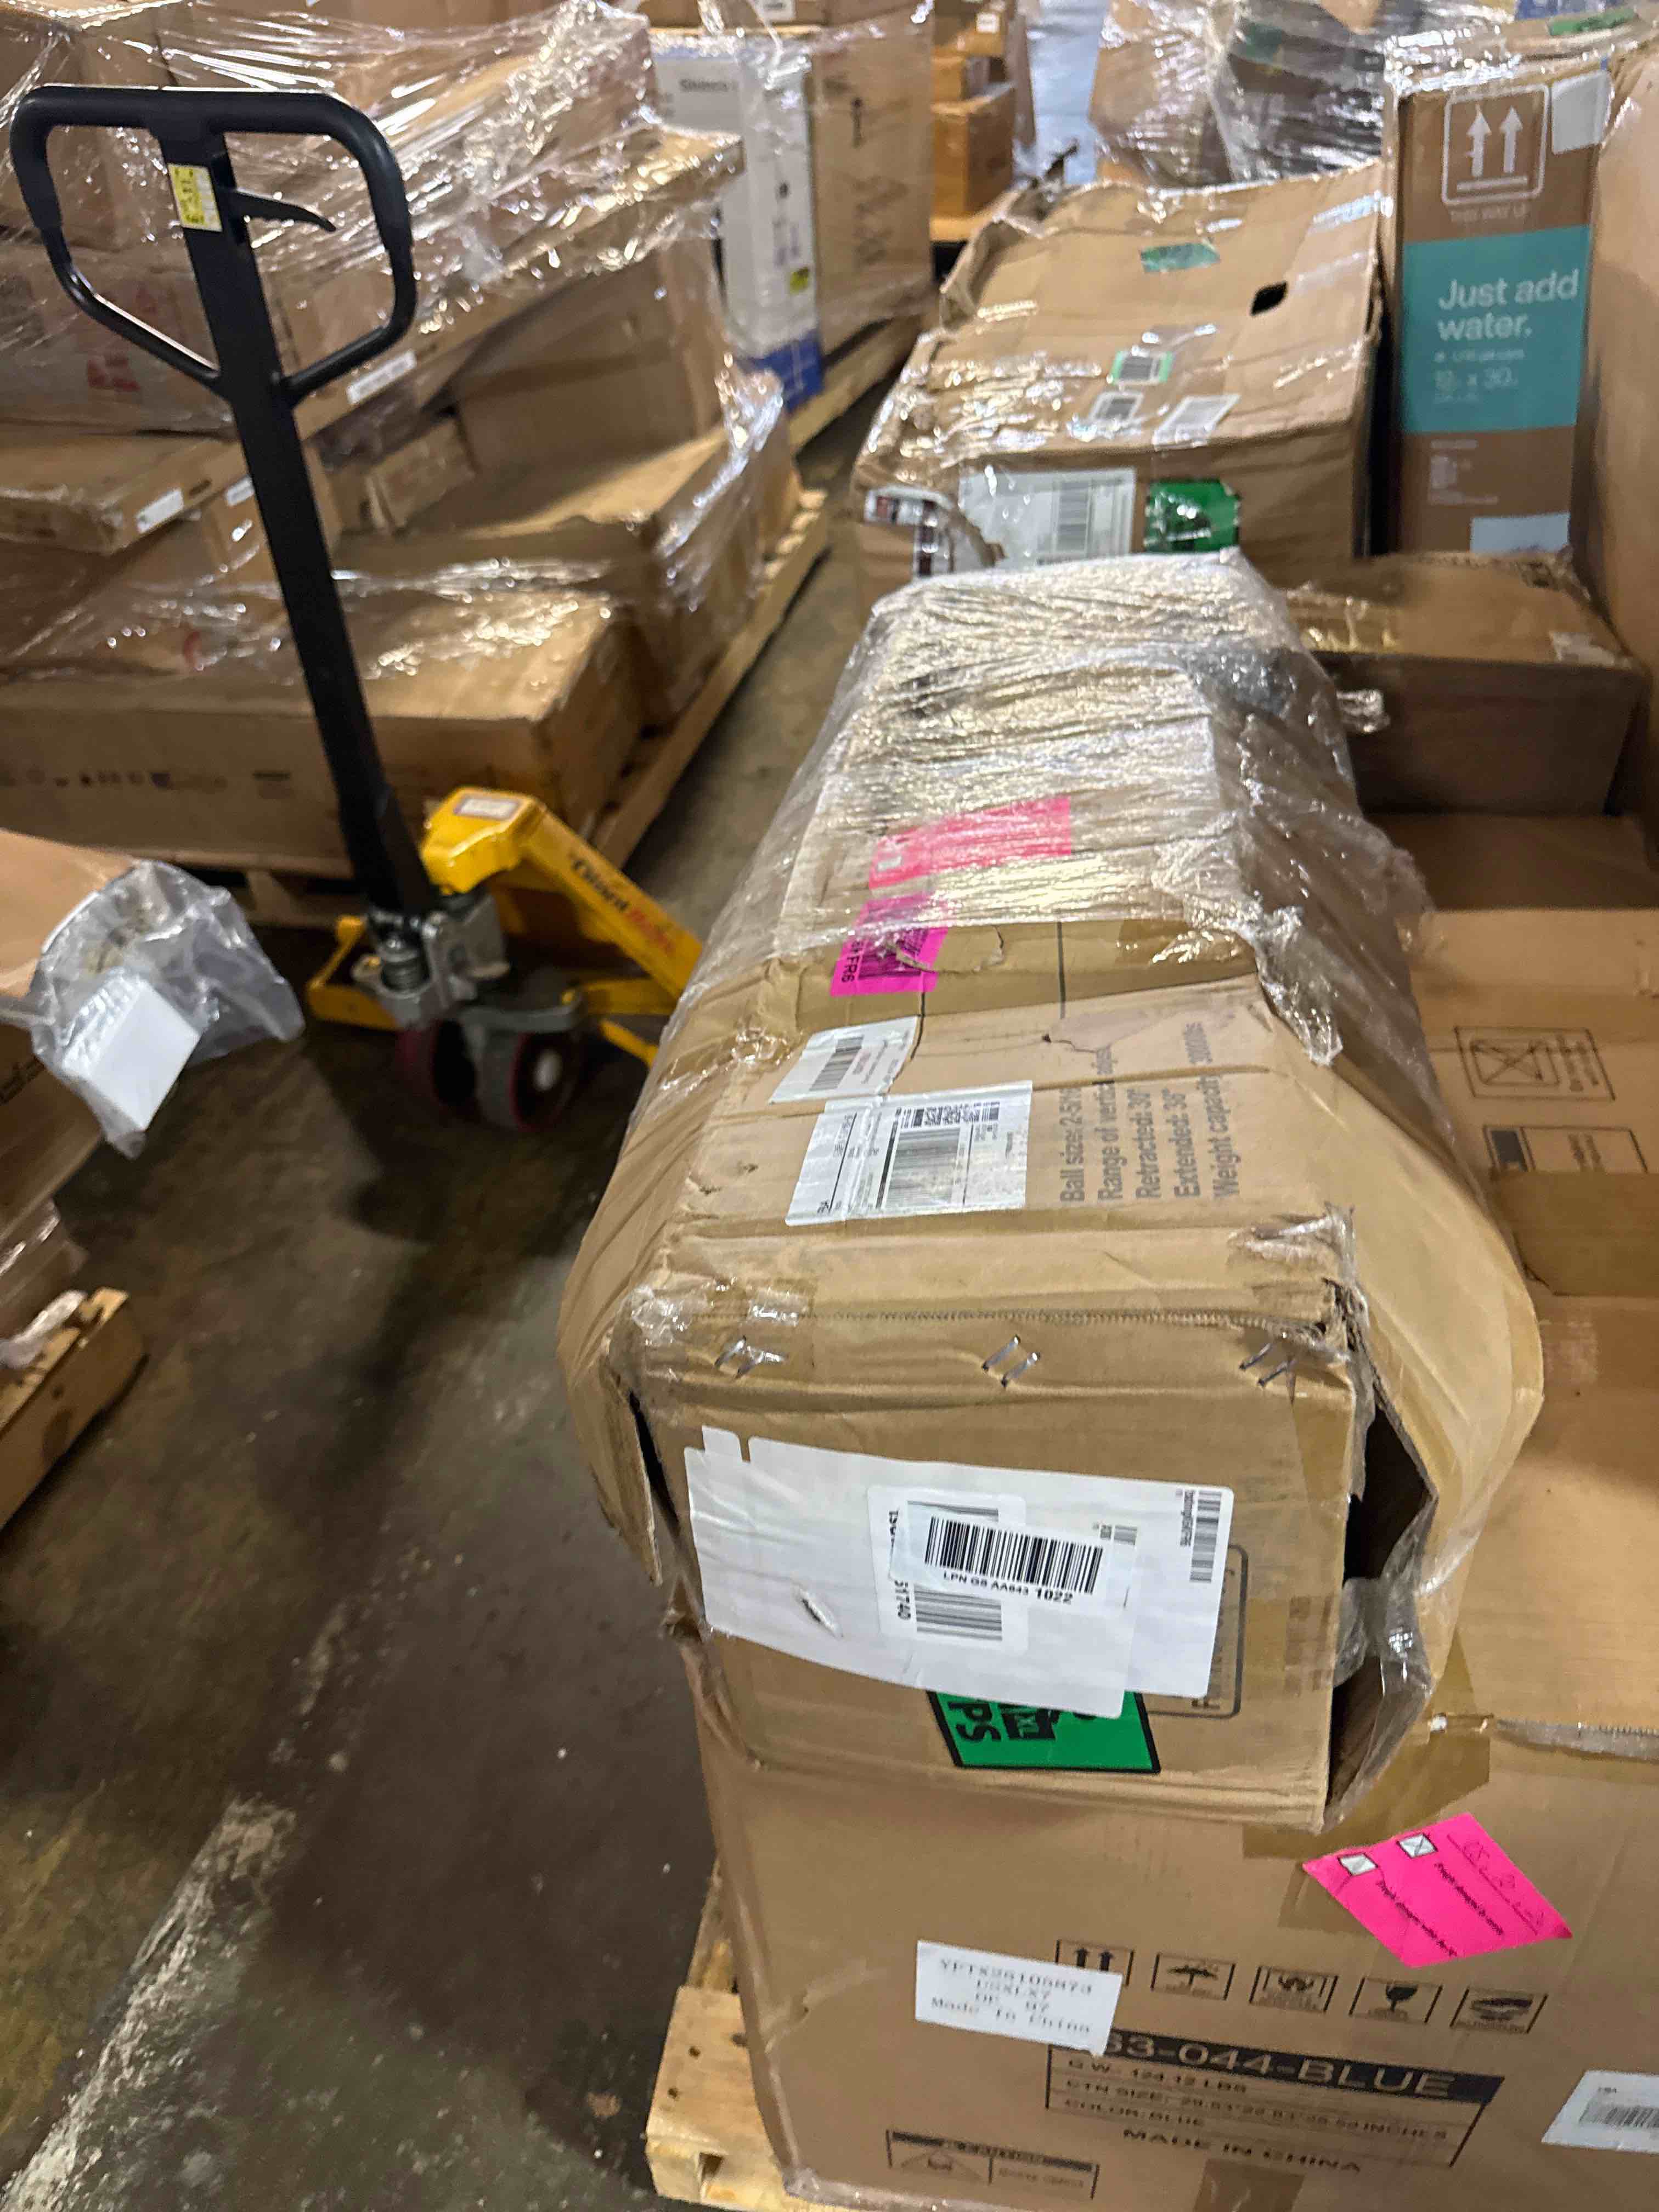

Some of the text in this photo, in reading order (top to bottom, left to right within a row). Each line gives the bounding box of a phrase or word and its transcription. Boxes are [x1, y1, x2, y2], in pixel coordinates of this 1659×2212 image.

[1438, 267, 1580, 310] Just add
[1437, 312, 1533, 340] water.
[1094, 1126, 1119, 1142] of
[1130, 1110, 1162, 1199] Retracted:
[1166, 1114, 1201, 1197] Extended:
[1059, 1169, 1085, 1202] Ball
[1097, 1146, 1128, 1200] Range
[1208, 1136, 1242, 1199] Weight
[943, 1571, 967, 1584] LPN
[1035, 1589, 1074, 1604] 1022
[932, 1997, 979, 2015] Made
[1029, 2013, 1090, 2033] China
[1123, 2129, 1361, 2173] MADE IN CHINA
